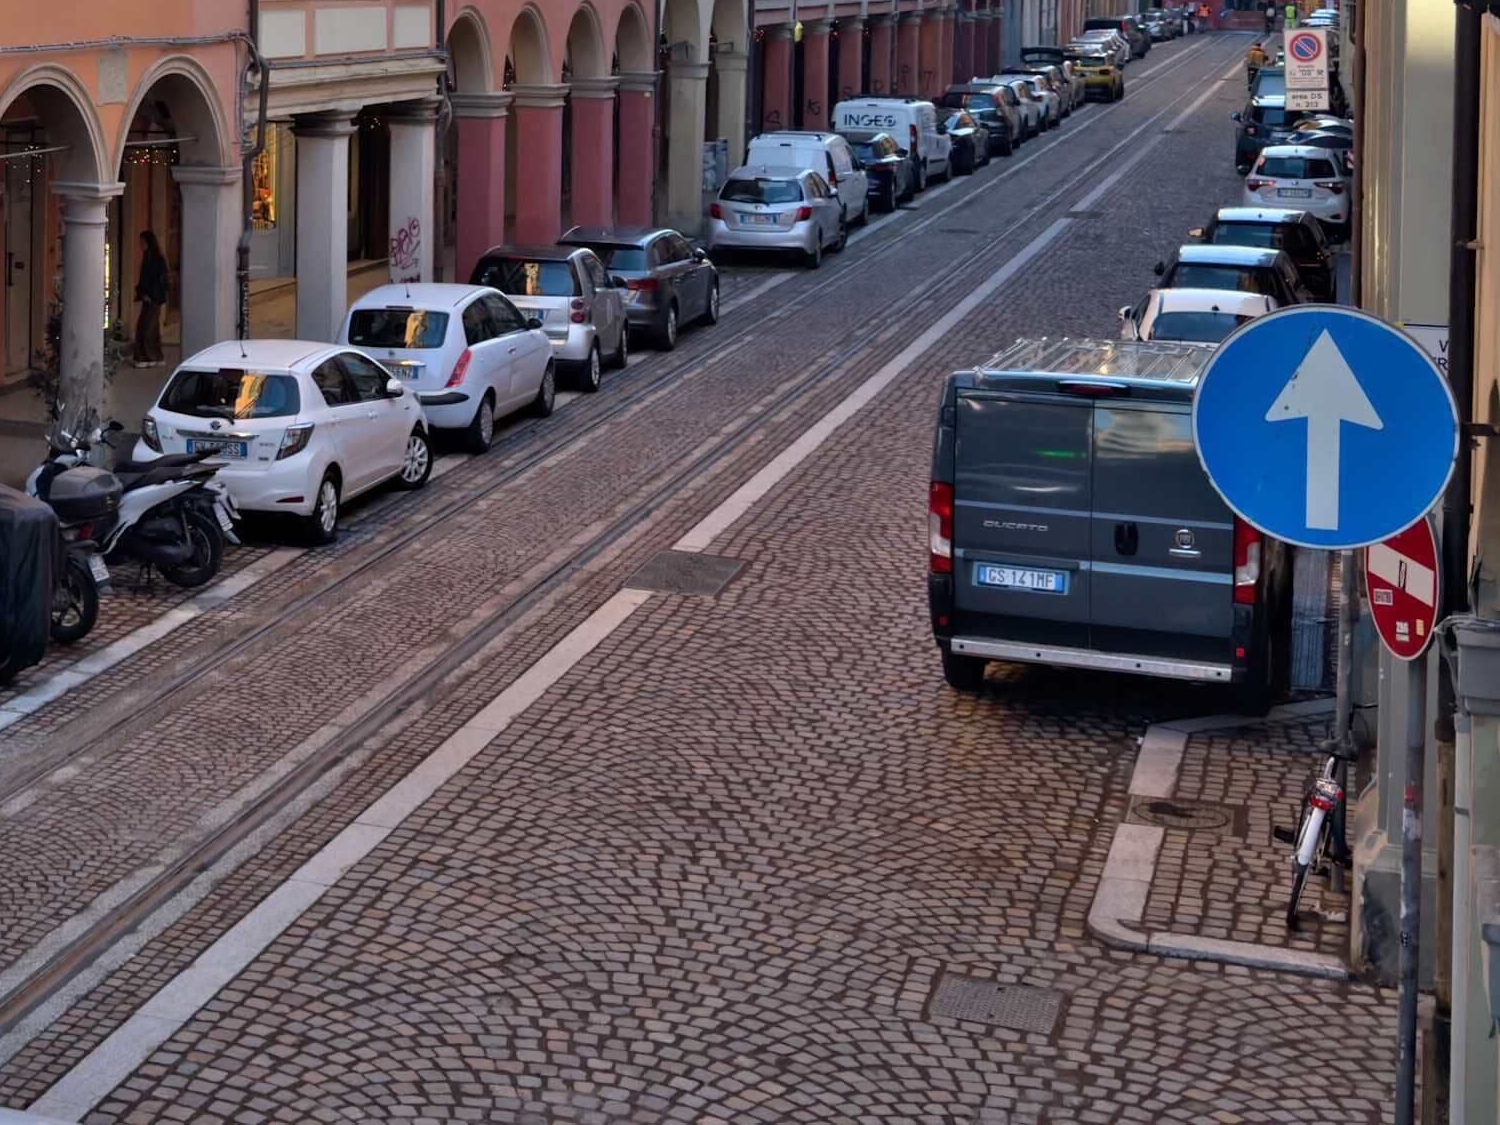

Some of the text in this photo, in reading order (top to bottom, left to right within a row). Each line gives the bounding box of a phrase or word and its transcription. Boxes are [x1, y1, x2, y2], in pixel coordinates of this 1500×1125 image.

[1310, 92, 1323, 100] DS
[982, 520, 1049, 532] DUCATO
[988, 568, 1006, 583] GS
